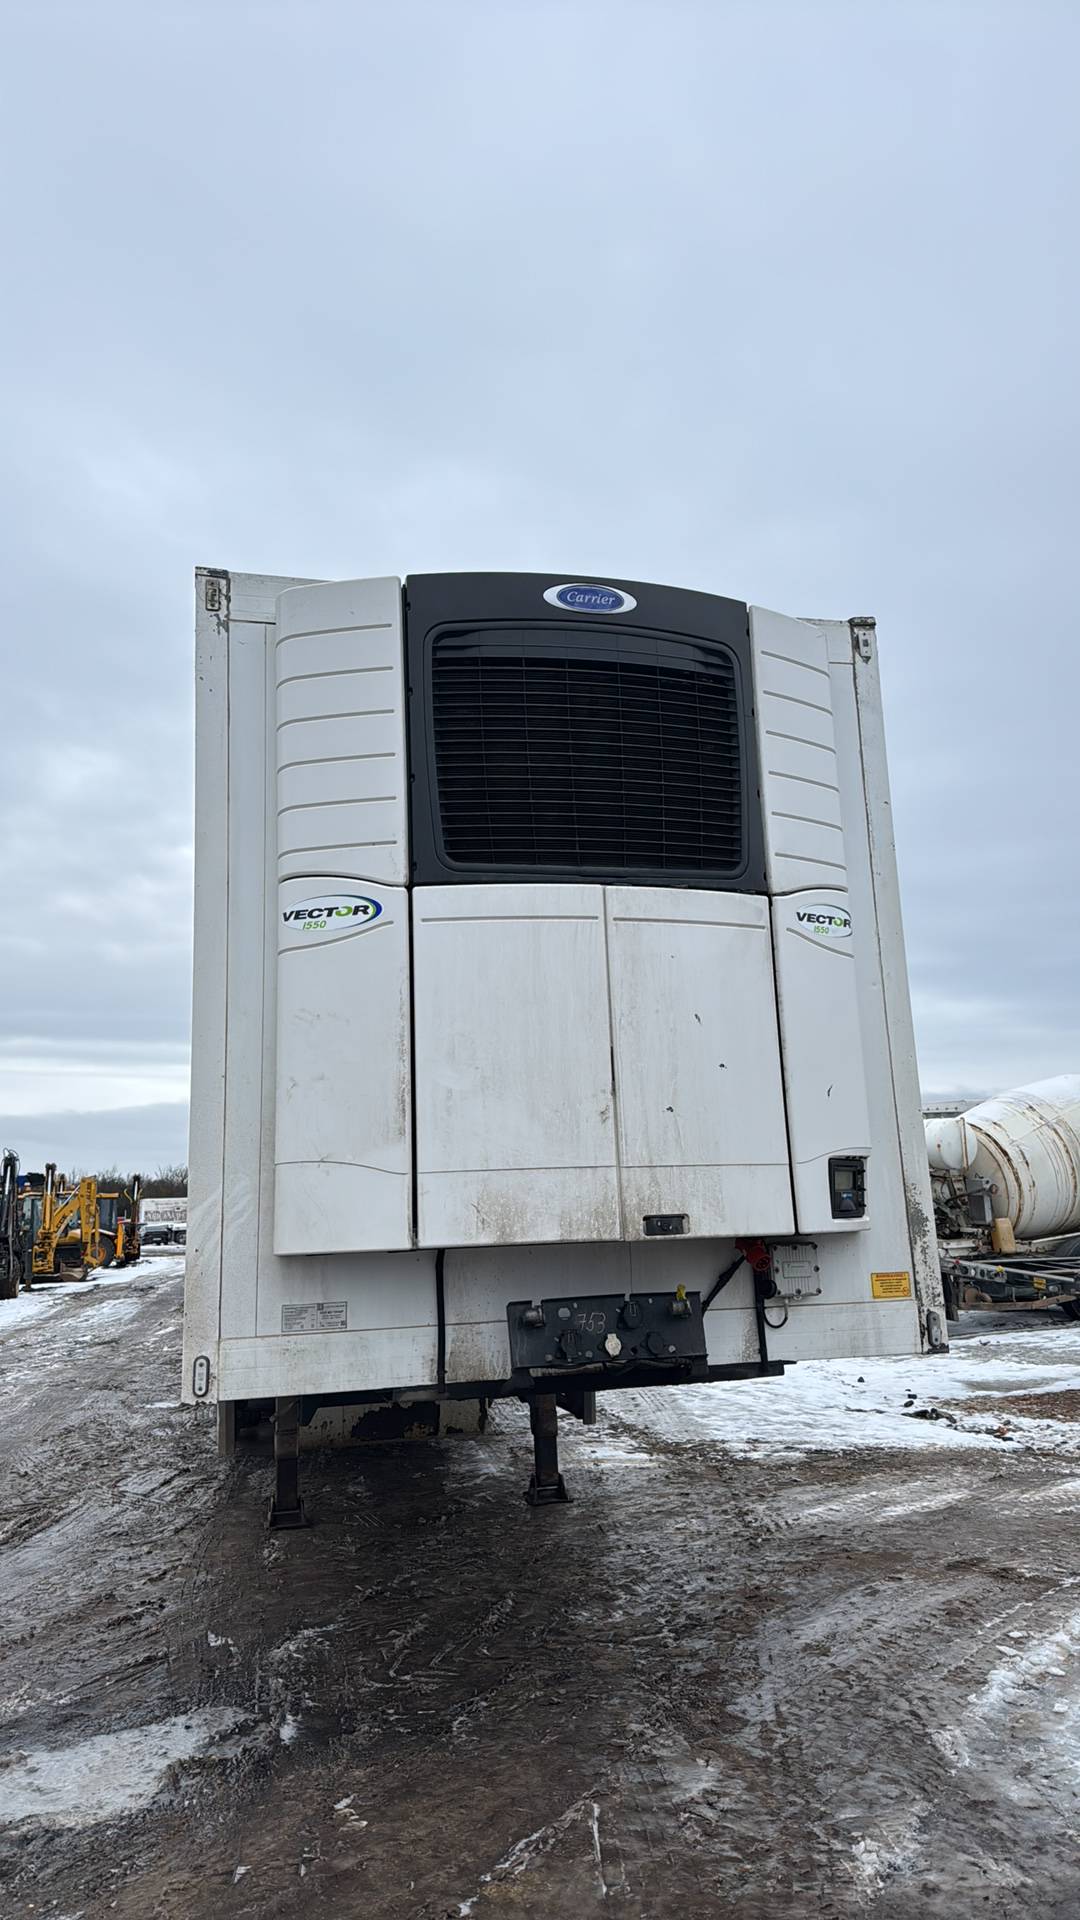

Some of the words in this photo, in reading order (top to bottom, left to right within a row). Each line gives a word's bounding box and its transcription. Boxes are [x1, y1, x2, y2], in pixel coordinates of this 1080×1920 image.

[566, 591, 616, 605] Carrier
[282, 904, 371, 922] VECTOR
[796, 911, 852, 929] VECTOR
[302, 920, 327, 930] 1550
[814, 925, 830, 935] 1550
[575, 1312, 608, 1334] 753
